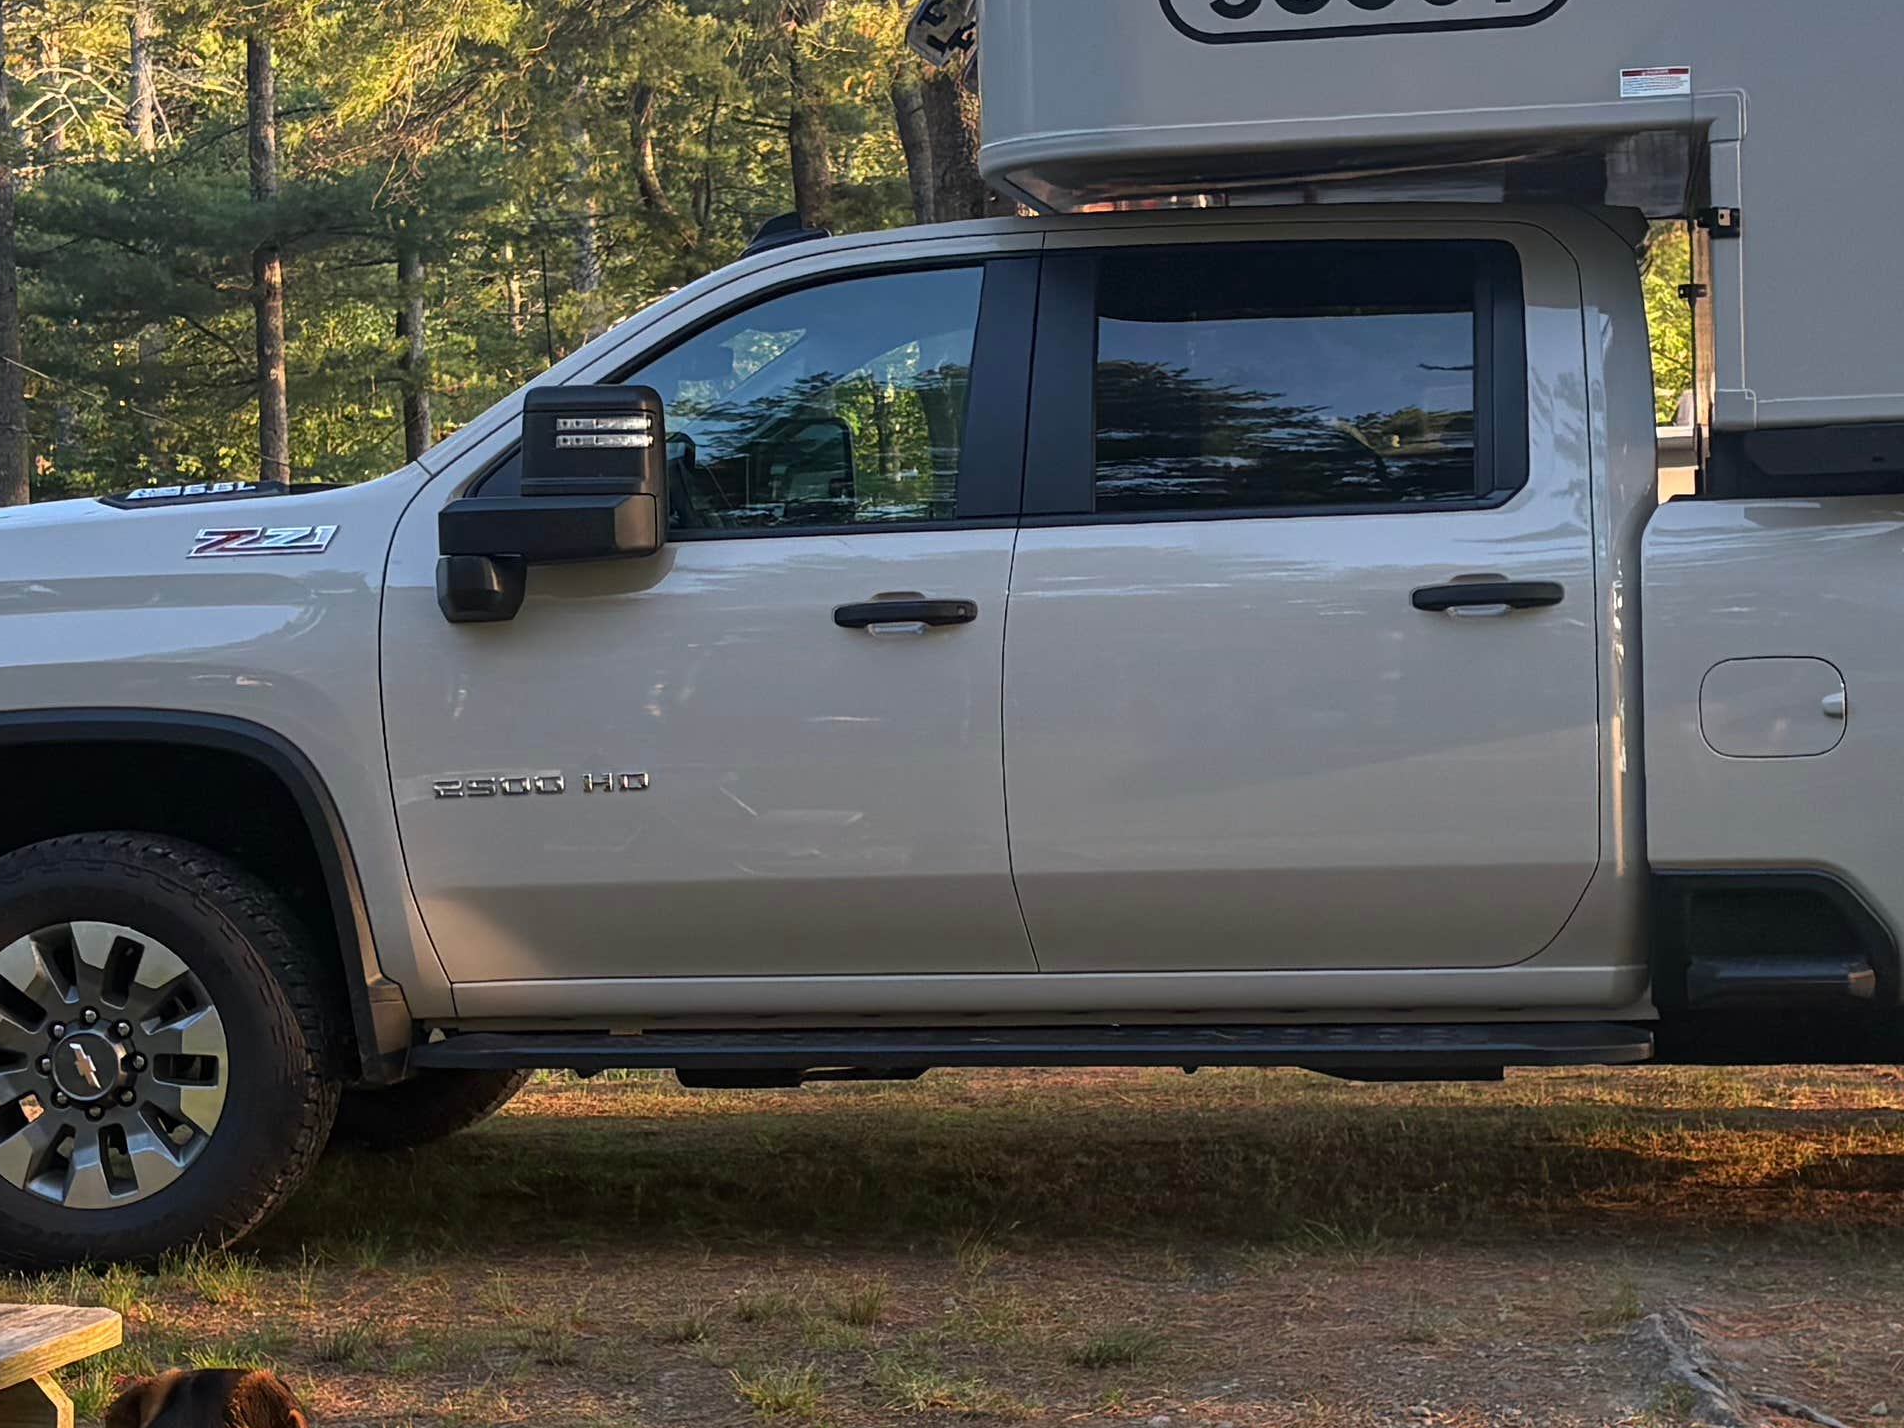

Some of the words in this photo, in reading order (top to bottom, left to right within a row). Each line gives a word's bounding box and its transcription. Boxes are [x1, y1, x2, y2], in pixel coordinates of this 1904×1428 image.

[186, 524, 340, 559] Z71
[433, 775, 565, 799] 2500
[583, 771, 649, 793] HD
